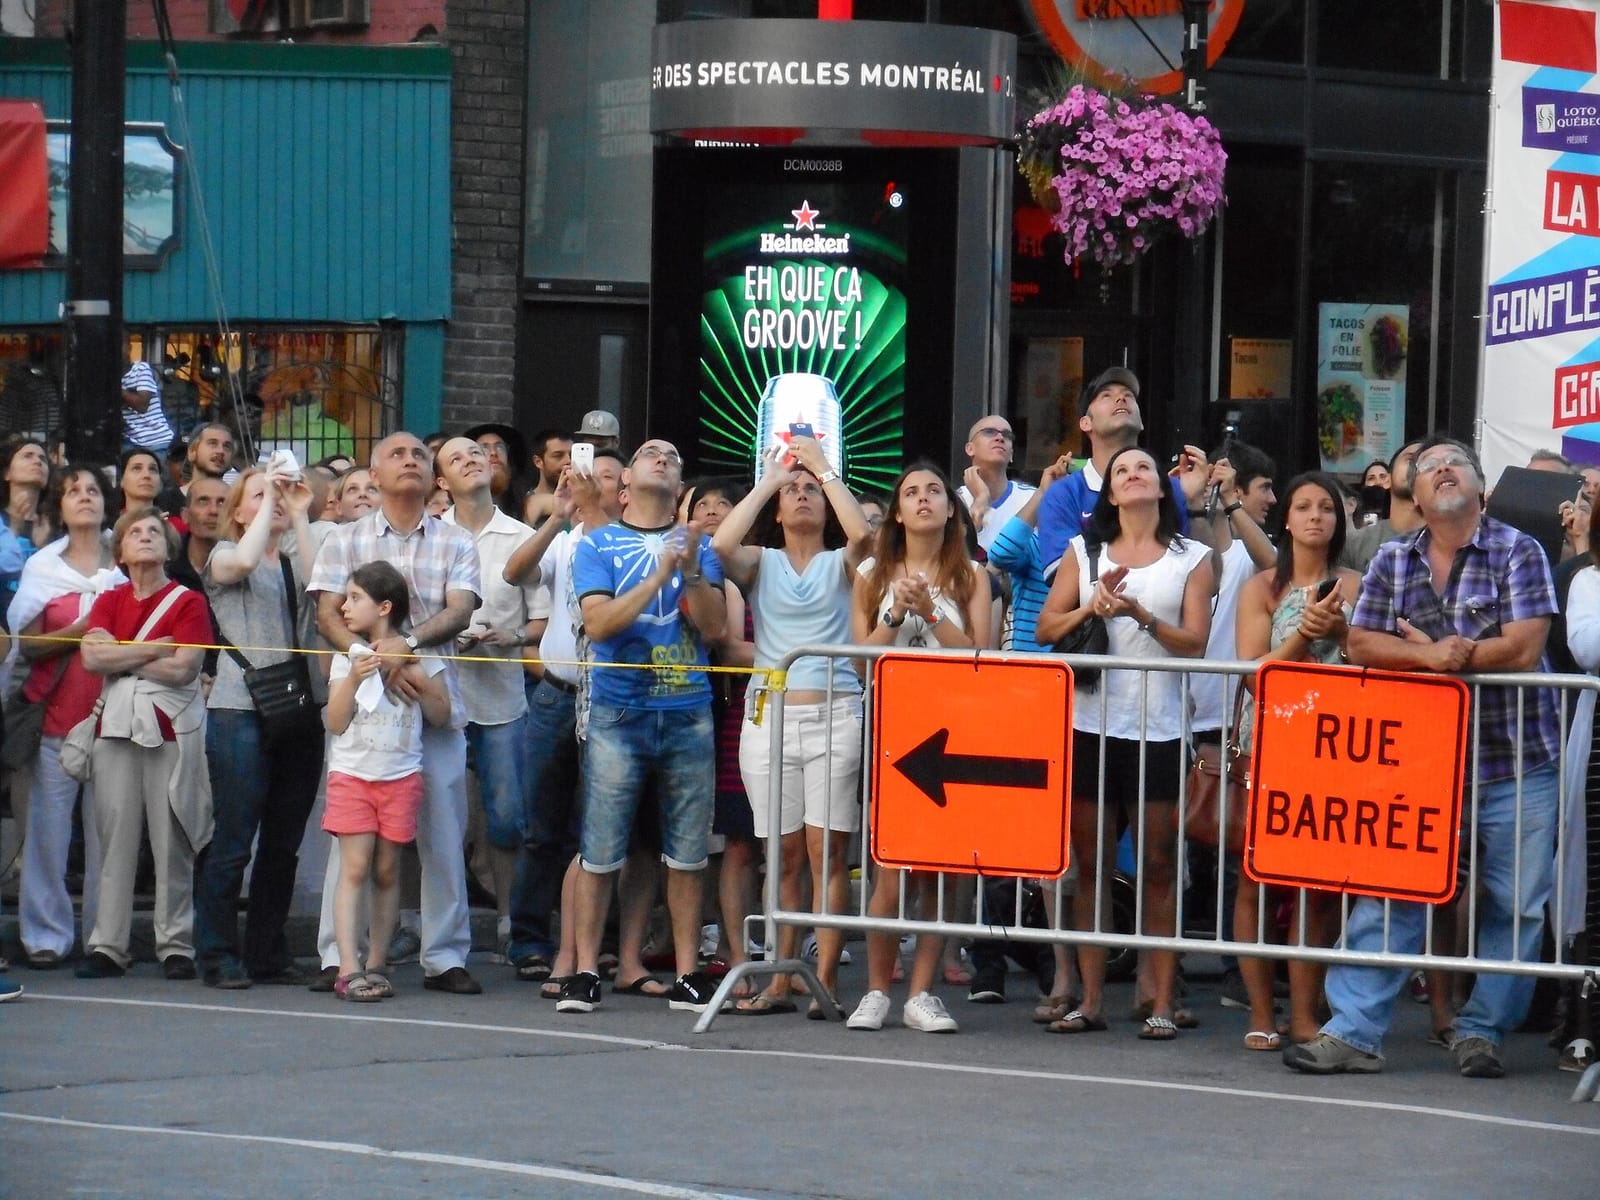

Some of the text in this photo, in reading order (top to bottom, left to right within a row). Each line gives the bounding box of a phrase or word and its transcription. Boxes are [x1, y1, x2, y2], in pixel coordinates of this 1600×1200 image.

[665, 63, 692, 87] DES
[698, 62, 850, 86] SPECTACLES
[860, 61, 985, 94] MONTRÉAL
[1564, 106, 1597, 117] LOTO
[783, 159, 843, 171] DCM0038B
[1551, 181, 1587, 229] LA
[760, 233, 850, 254] Heineken
[745, 265, 862, 305] EH QUE ÇA
[743, 309, 846, 350] GROOVE
[1330, 317, 1366, 330] TACOS
[1340, 331, 1354, 343] EN
[1332, 345, 1362, 357] FOLIE
[1314, 713, 1402, 767] RUE
[1265, 790, 1441, 854] BARRÉE
